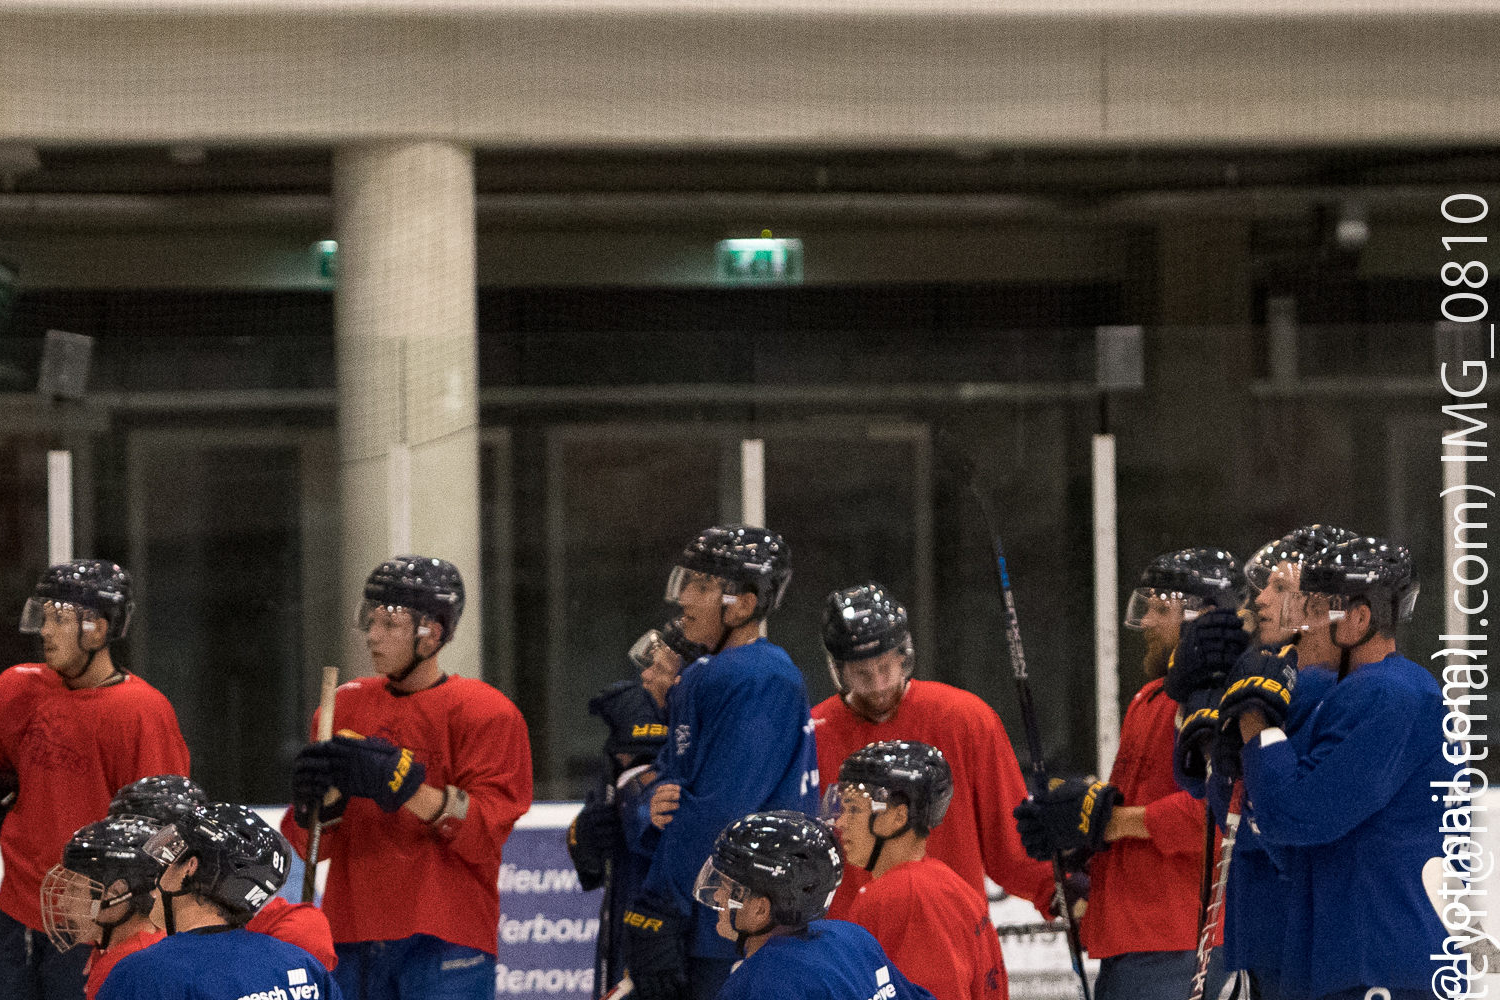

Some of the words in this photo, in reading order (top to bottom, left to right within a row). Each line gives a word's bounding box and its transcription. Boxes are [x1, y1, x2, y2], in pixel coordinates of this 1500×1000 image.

[1078, 780, 1109, 835] UER
[272, 851, 285, 874] 81
[498, 913, 599, 944] erbou
